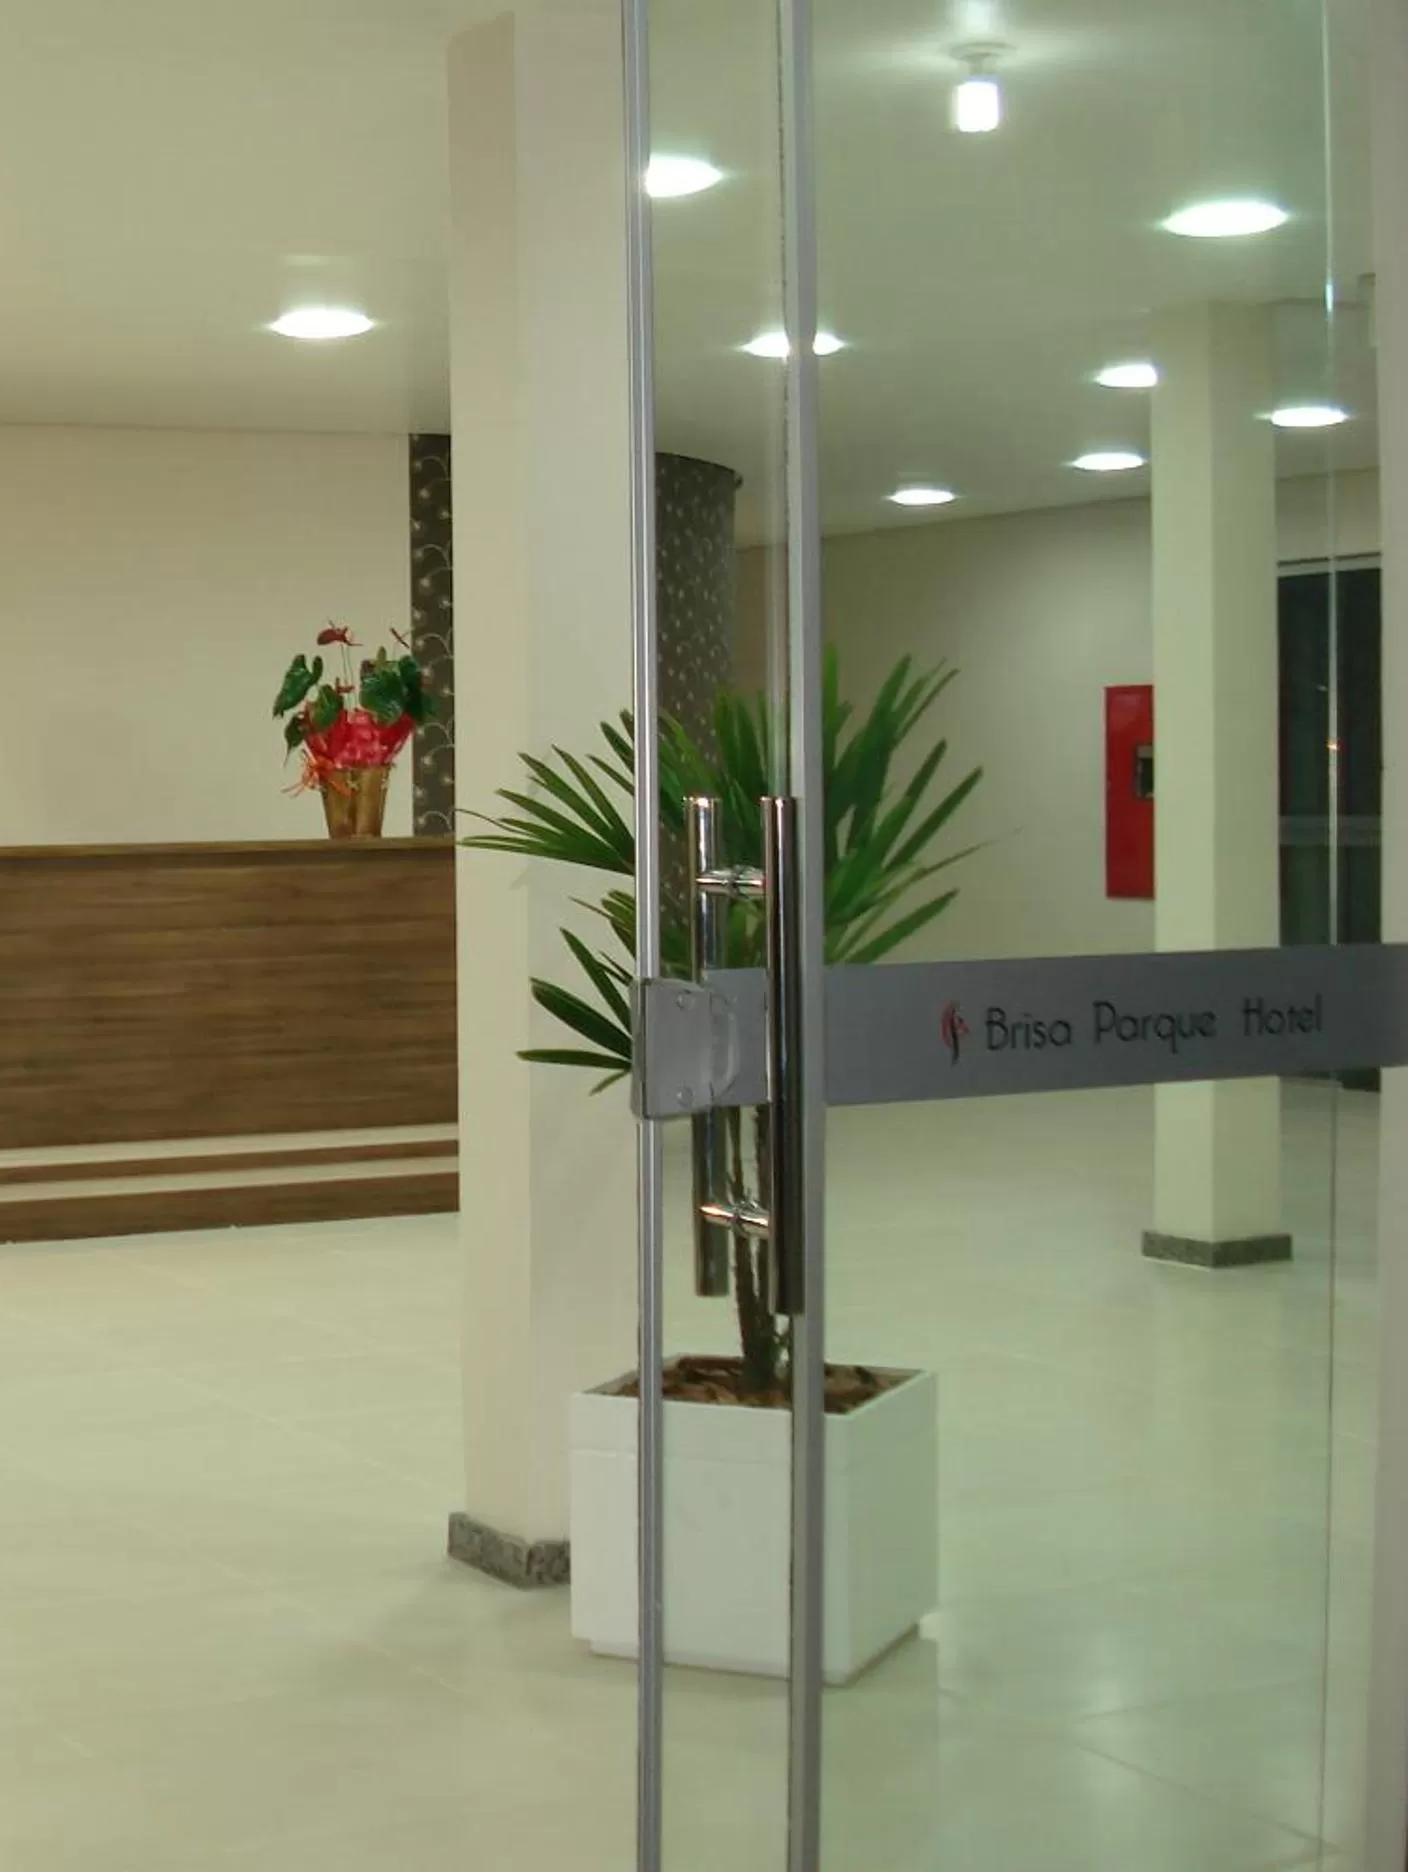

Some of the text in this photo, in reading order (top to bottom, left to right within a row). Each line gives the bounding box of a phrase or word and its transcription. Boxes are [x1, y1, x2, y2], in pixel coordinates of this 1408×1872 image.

[985, 994, 1323, 1054] Brisa Parque Hotel
